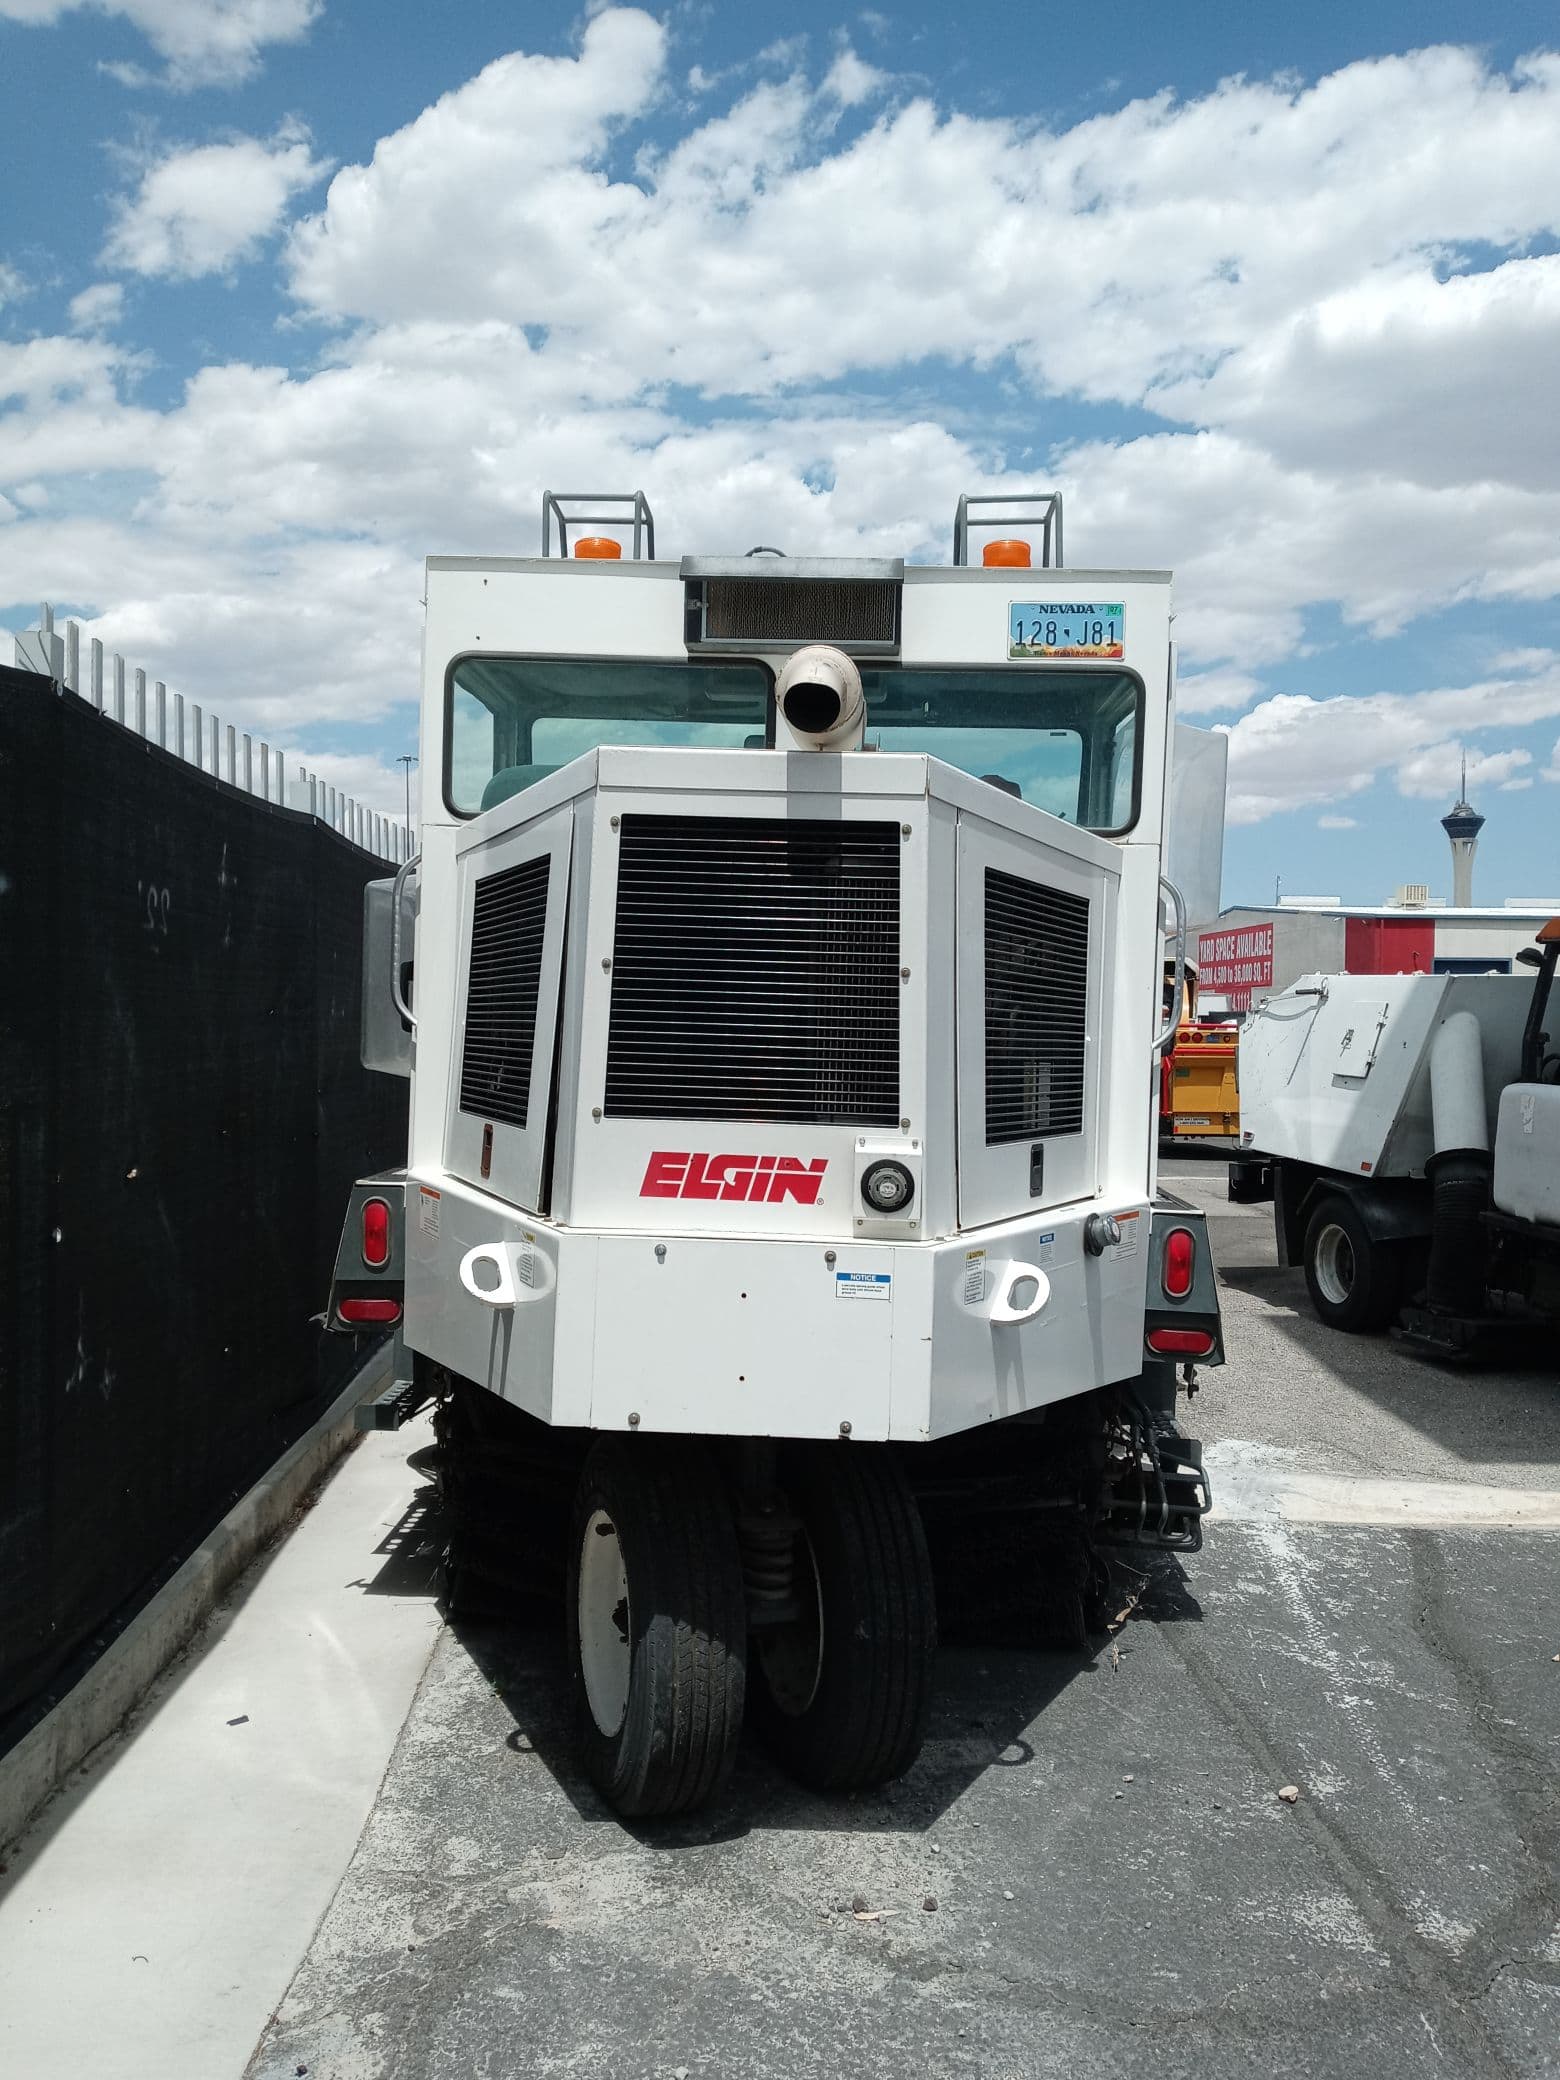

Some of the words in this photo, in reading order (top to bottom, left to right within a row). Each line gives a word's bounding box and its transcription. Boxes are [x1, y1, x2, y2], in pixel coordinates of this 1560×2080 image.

[1039, 604, 1095, 614] NEVADA
[1015, 620, 1057, 647] 128
[1077, 620, 1118, 647] J81
[1199, 939, 1214, 963] YARD
[1215, 935, 1235, 962] SPACE
[1236, 929, 1272, 959] AVAILABLE
[1199, 967, 1213, 985] FROM
[1227, 965, 1233, 983] to
[1253, 962, 1263, 983] SQ.
[639, 1151, 829, 1205] ELGIN
[850, 1274, 877, 1282] NOTICE
